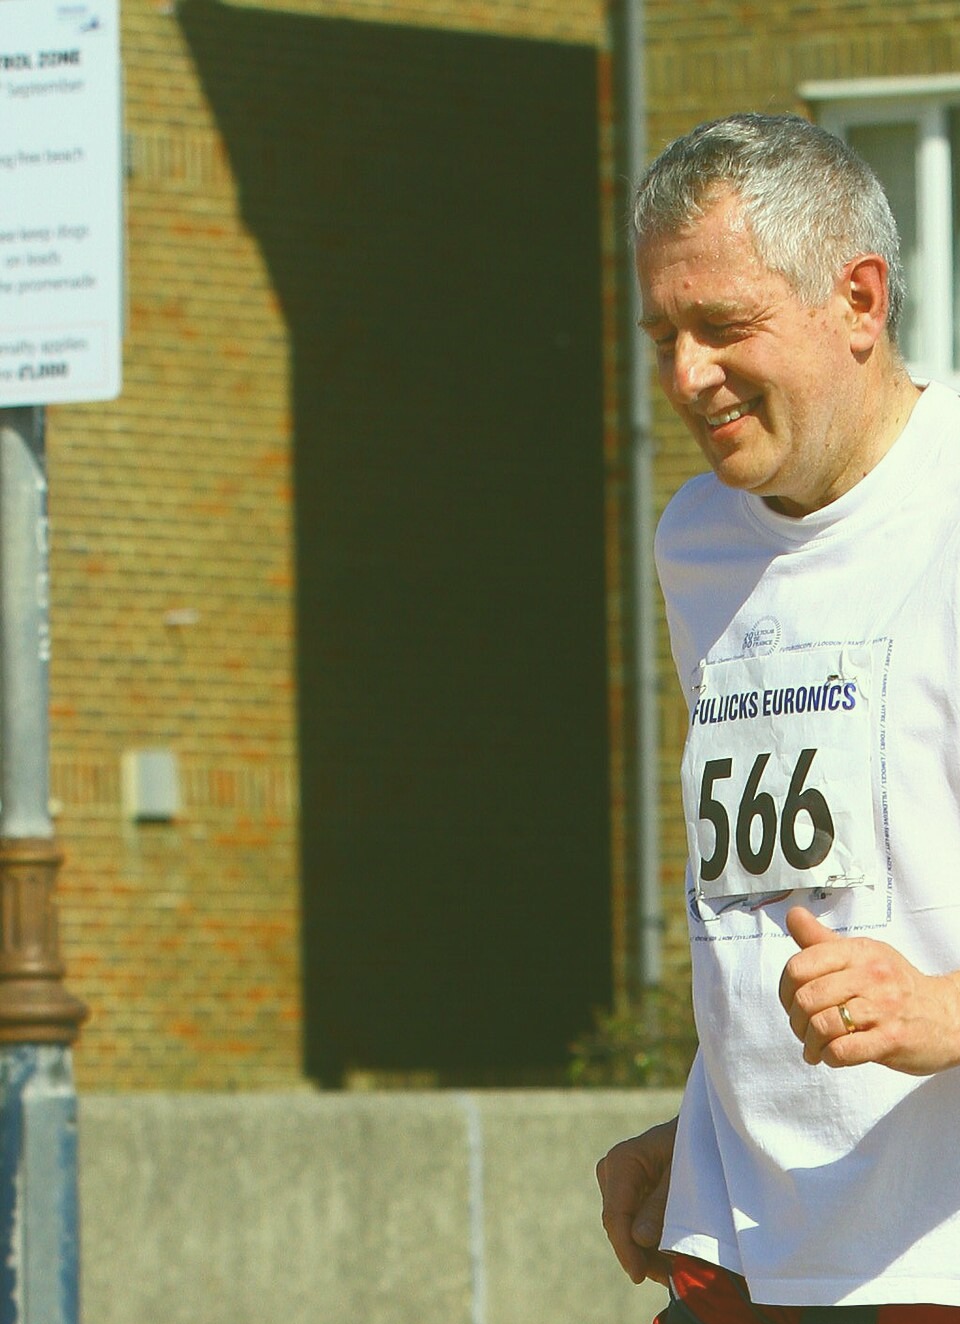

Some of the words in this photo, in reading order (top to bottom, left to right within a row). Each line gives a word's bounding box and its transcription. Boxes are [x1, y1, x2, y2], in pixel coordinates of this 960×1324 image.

[692, 691, 758, 726] FULLICKS
[763, 682, 857, 717] EURONICS
[699, 748, 835, 881] 566
